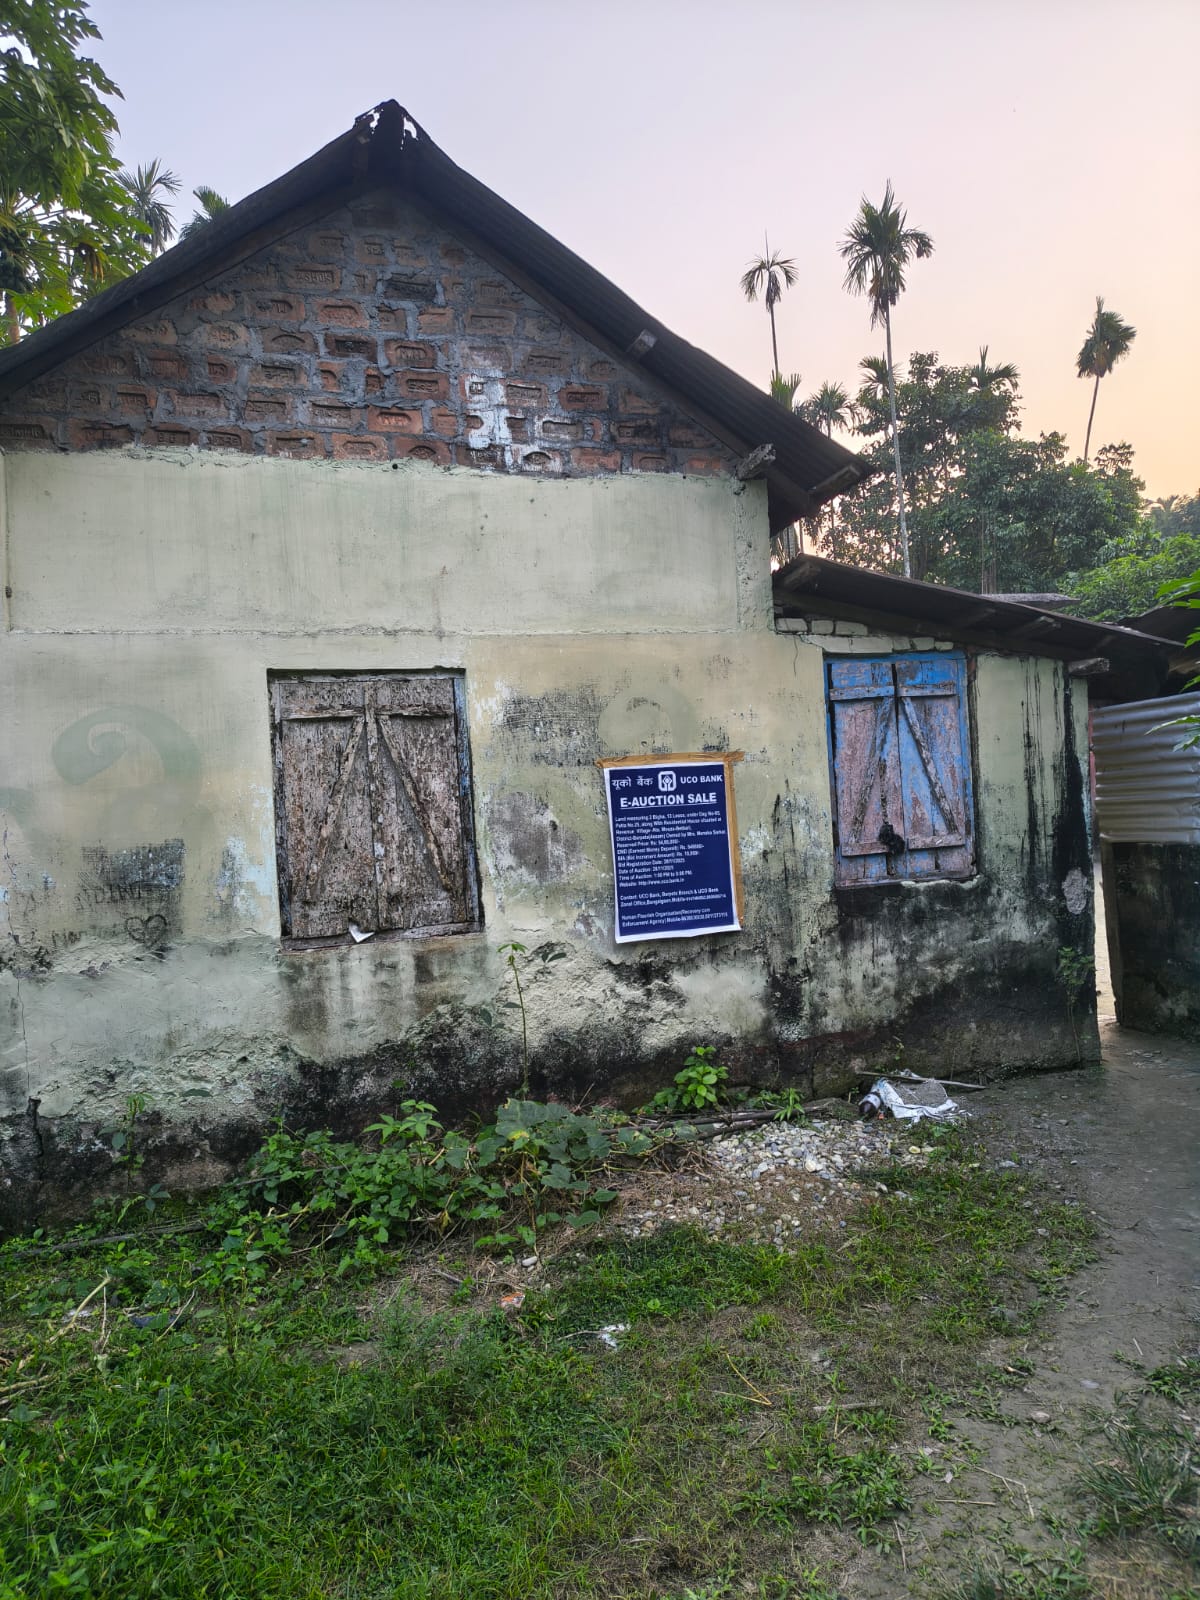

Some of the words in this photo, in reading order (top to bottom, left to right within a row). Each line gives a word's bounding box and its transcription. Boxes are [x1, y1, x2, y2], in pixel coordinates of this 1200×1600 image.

[611, 776, 631, 790] यूको
[680, 775, 697, 784] UCO
[699, 774, 723, 783] BANK
[620, 794, 684, 807] E-AUCTION
[687, 792, 716, 803] SALE
